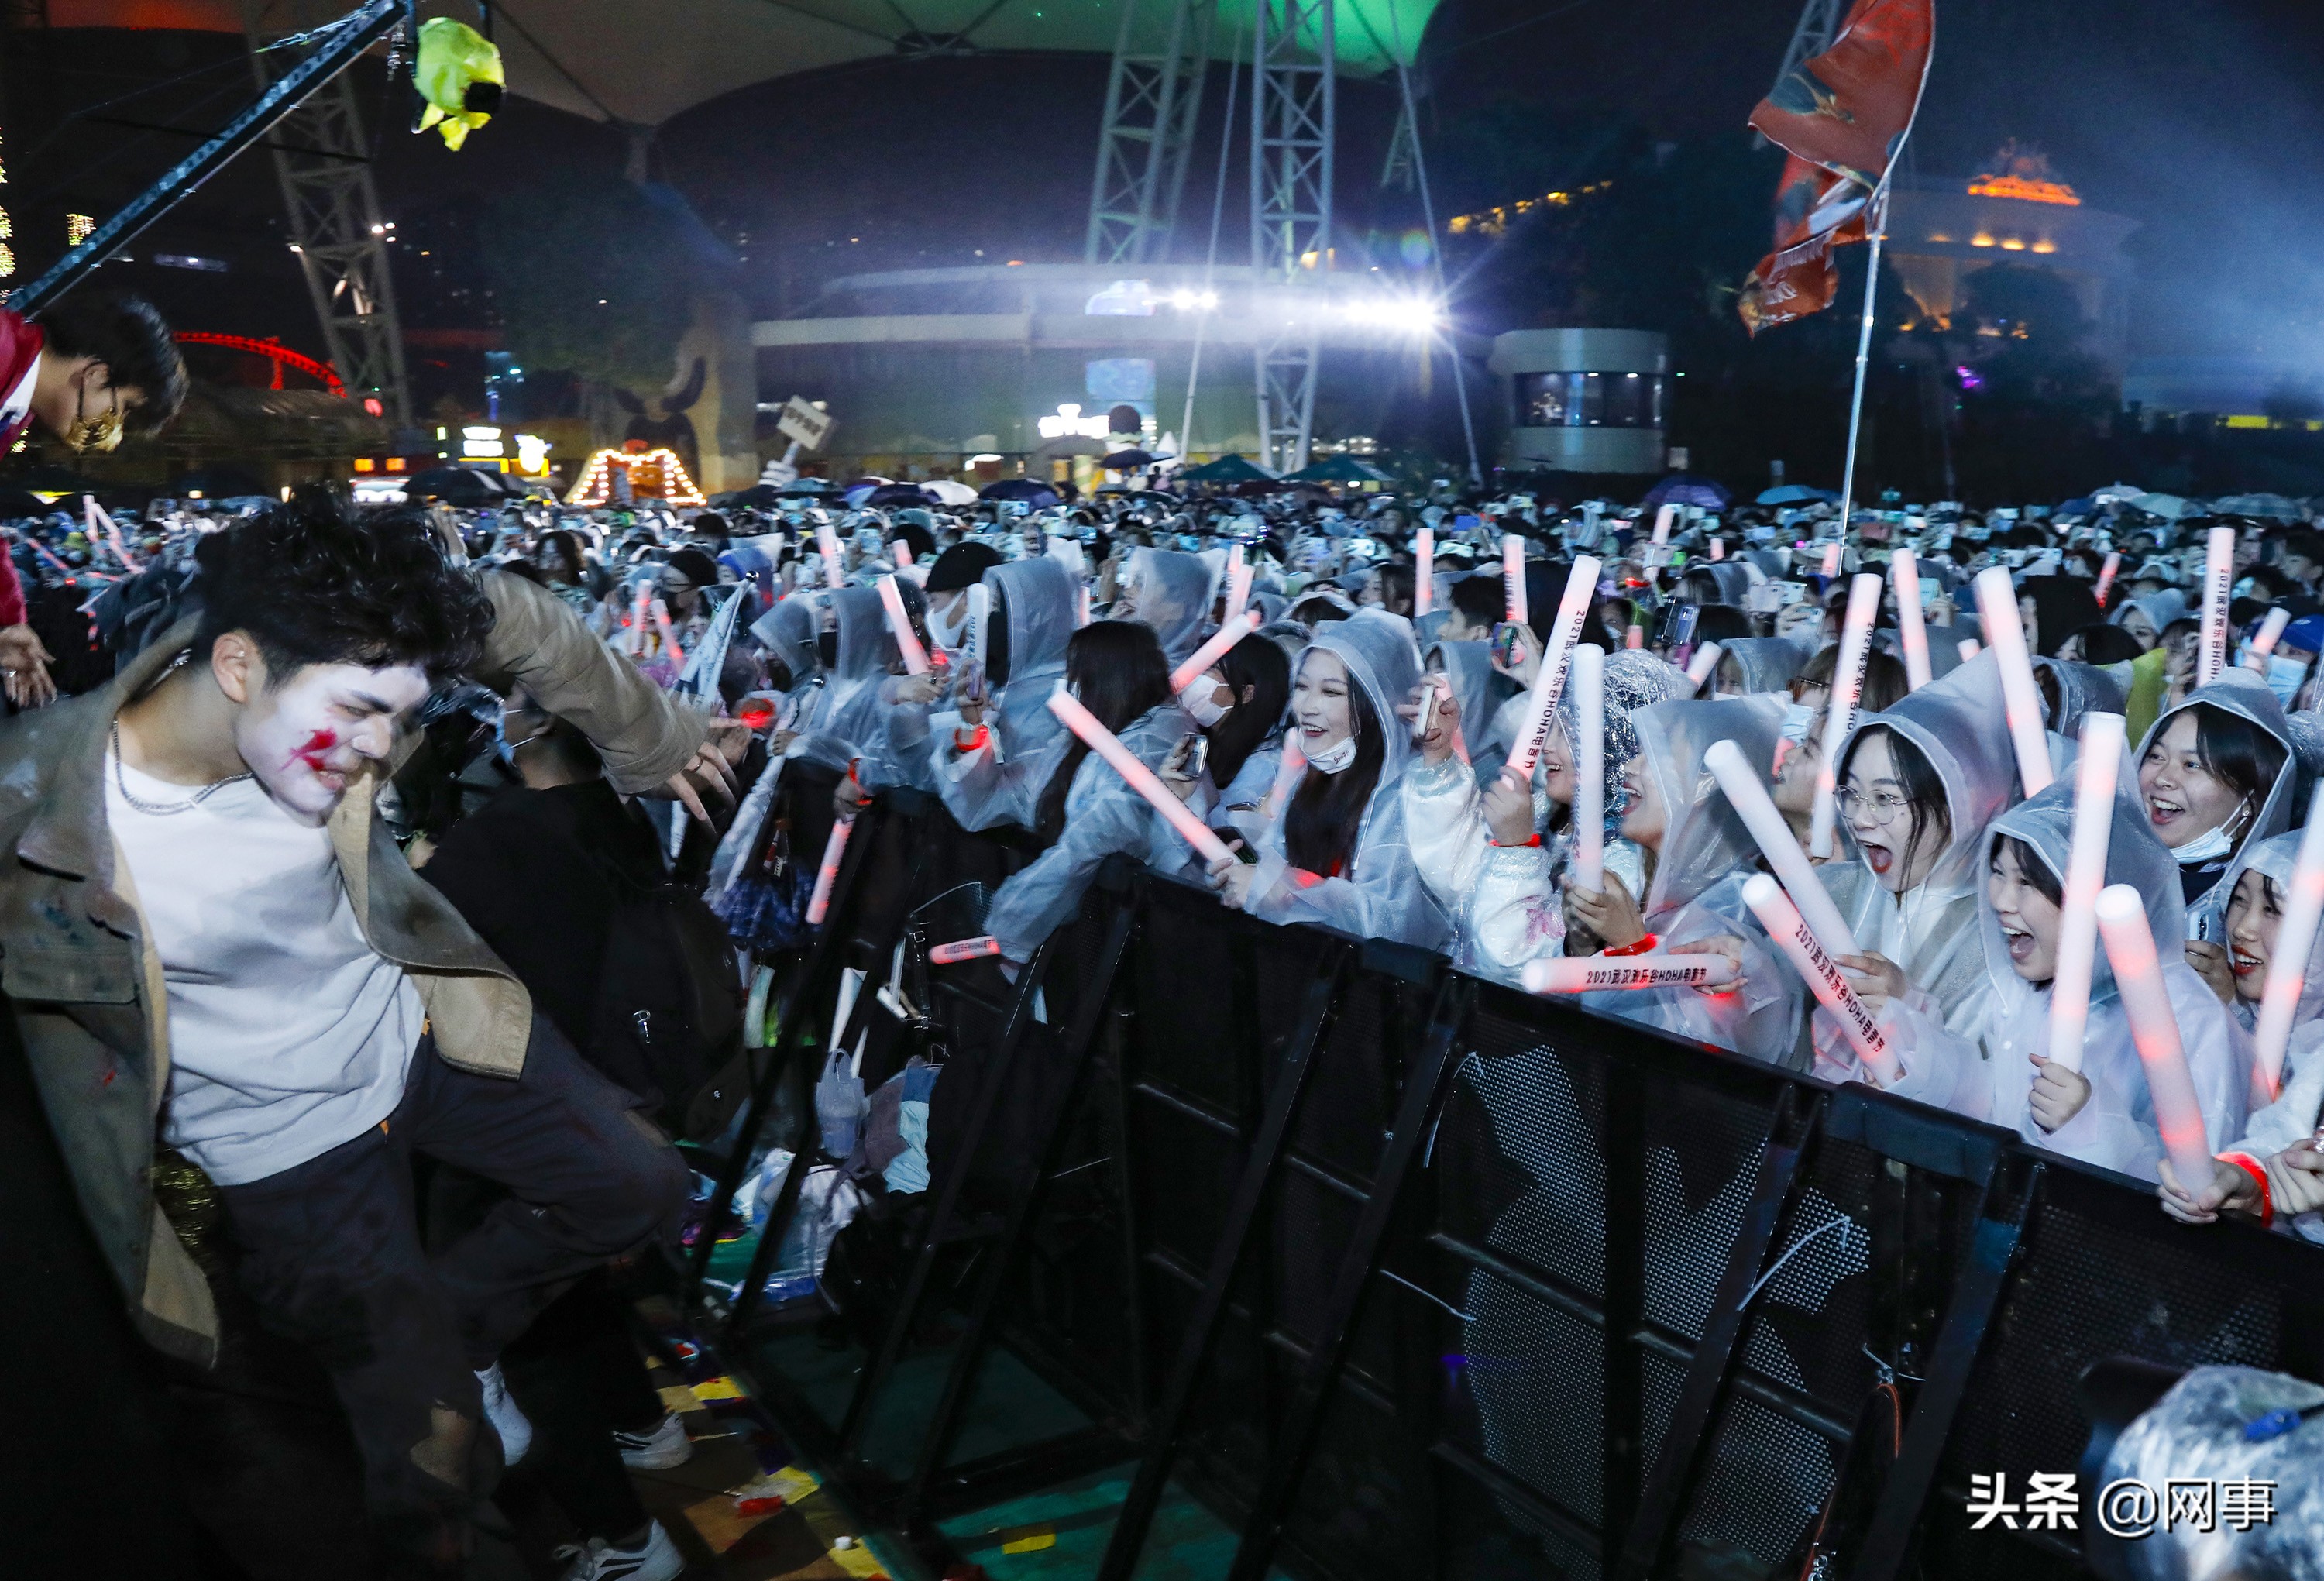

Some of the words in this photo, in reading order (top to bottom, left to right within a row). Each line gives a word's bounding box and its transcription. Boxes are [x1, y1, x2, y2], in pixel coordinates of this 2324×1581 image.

[1586, 967, 1707, 985] 2021武汉欢乐谷HOHA电音节
[1794, 923, 1886, 1053] 2021武汉欢乐谷HOHA电音节
